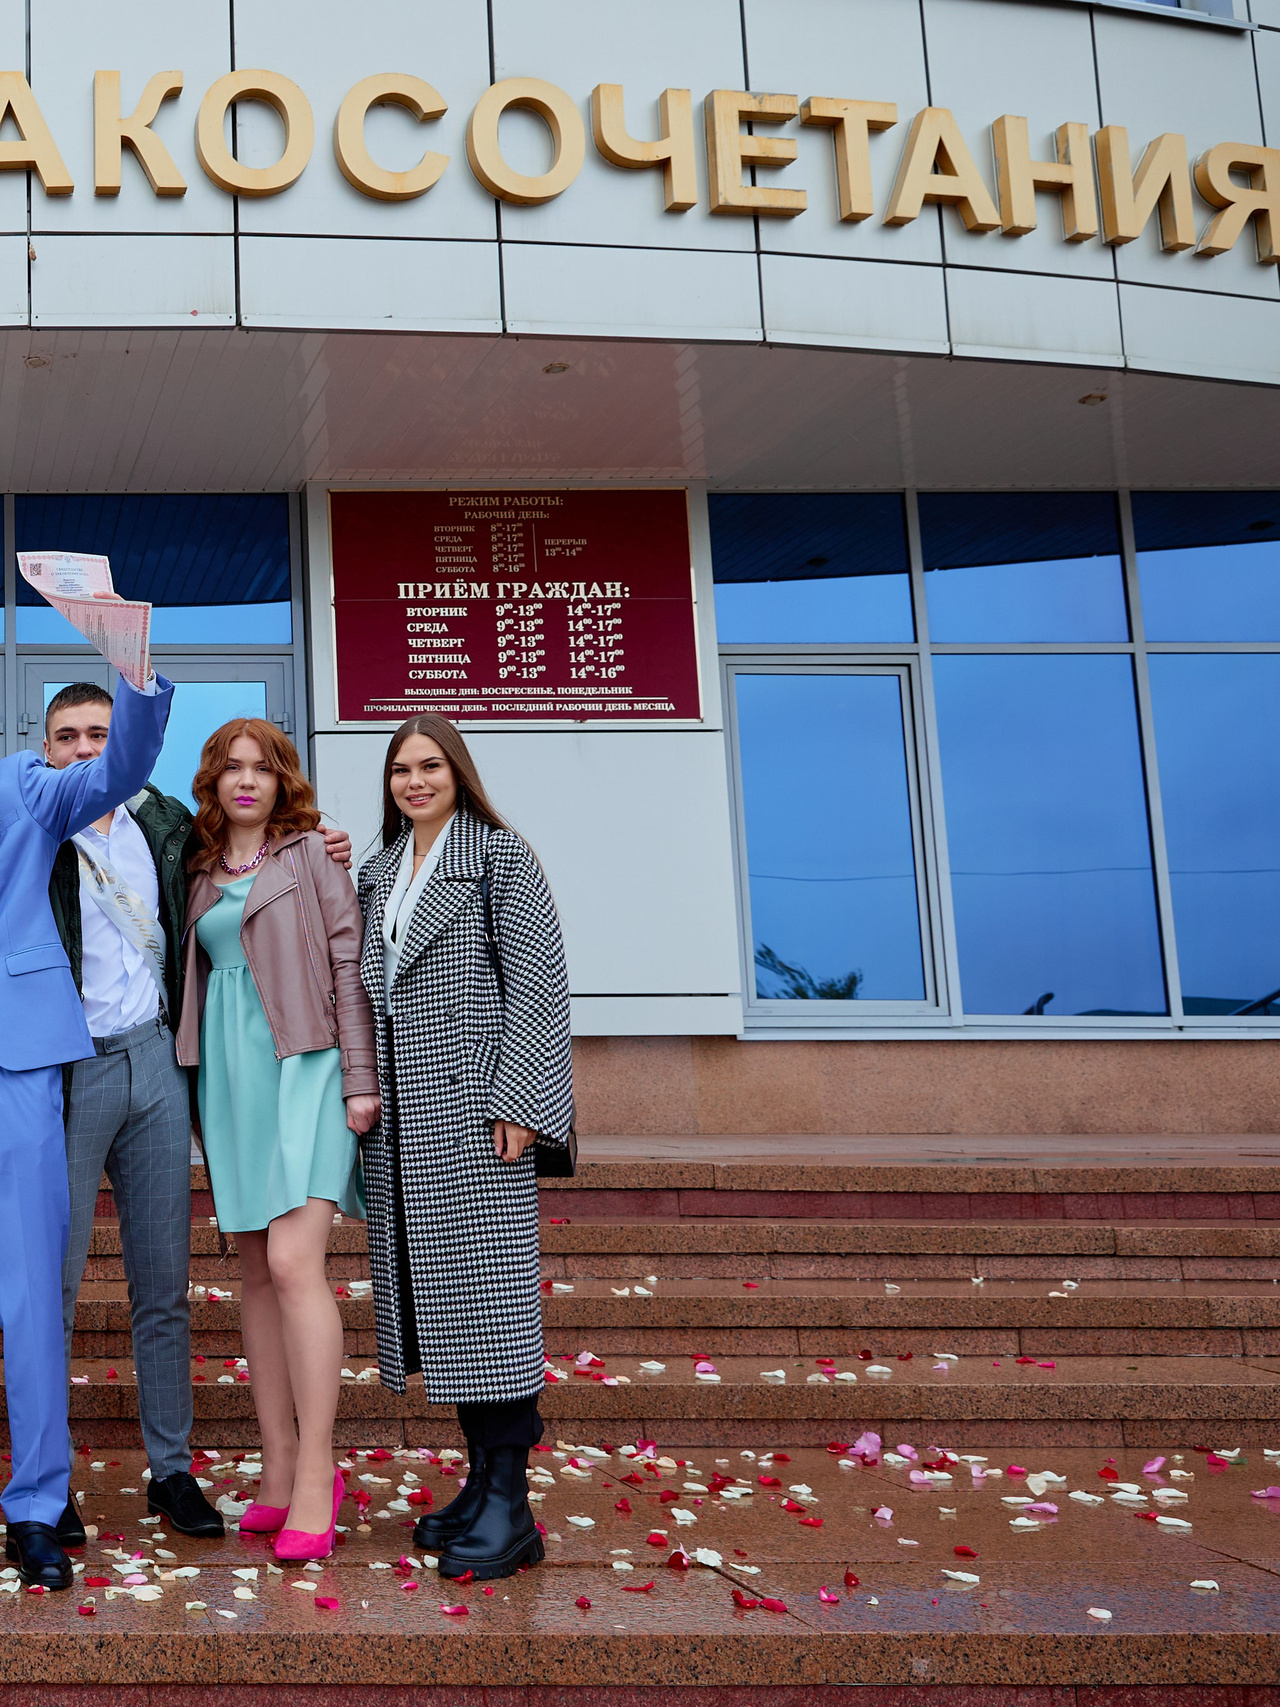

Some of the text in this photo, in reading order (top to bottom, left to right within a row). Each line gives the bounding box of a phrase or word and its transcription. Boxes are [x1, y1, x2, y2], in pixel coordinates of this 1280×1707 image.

[449, 497, 563, 506] РЕЖИМ РАБОТЫ:
[465, 510, 549, 520] РАБОЧИЙ ДЕНЬ:
[397, 579, 630, 602] ПРИЁМ ГРАЖДАН:
[406, 607, 467, 616] ВТОРНИК
[407, 623, 449, 634] СРЕДА
[408, 639, 465, 647] ЧЕТВЕРГ
[408, 654, 471, 664] ПЯТНИЦА
[409, 670, 468, 679] СУББОТА
[458, 688, 479, 696] ДНИ:
[481, 687, 555, 695] ВОСКРЕСЕНЬЕ,
[557, 687, 633, 696] ПОНЕДЕЛЬНИК
[492, 702, 554, 712] ПОСЛЕДНИЙ
[604, 703, 632, 712] ДЕНЬ
[633, 703, 675, 711] МЕСЯЦА
